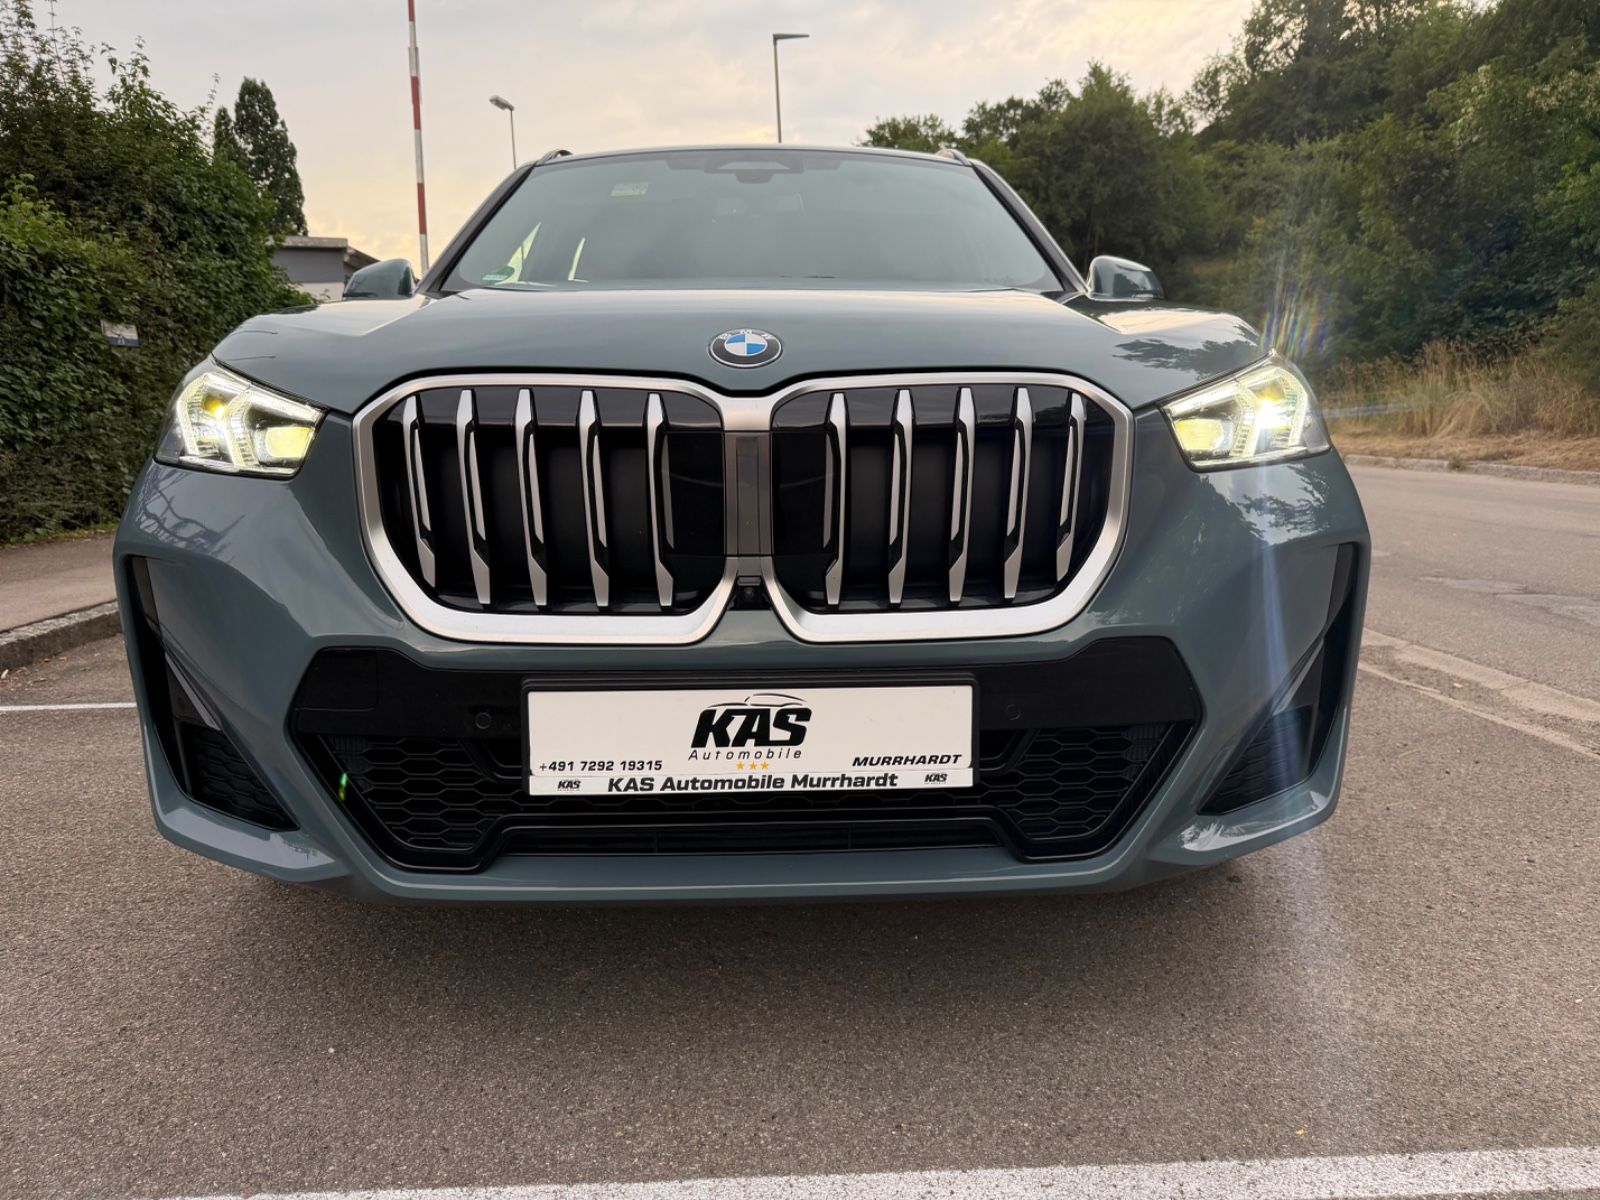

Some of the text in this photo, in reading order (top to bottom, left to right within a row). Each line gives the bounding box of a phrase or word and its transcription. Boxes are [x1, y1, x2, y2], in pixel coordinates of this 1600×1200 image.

[690, 707, 813, 748] KAS
[688, 748, 802, 761] Automobile
[852, 754, 963, 767] MURRHARDT
[540, 760, 663, 772] +491 7292 19315
[607, 772, 899, 793] KAS Automobile Murrhardt
[924, 773, 948, 783] KAS
[557, 780, 581, 790] KAS
